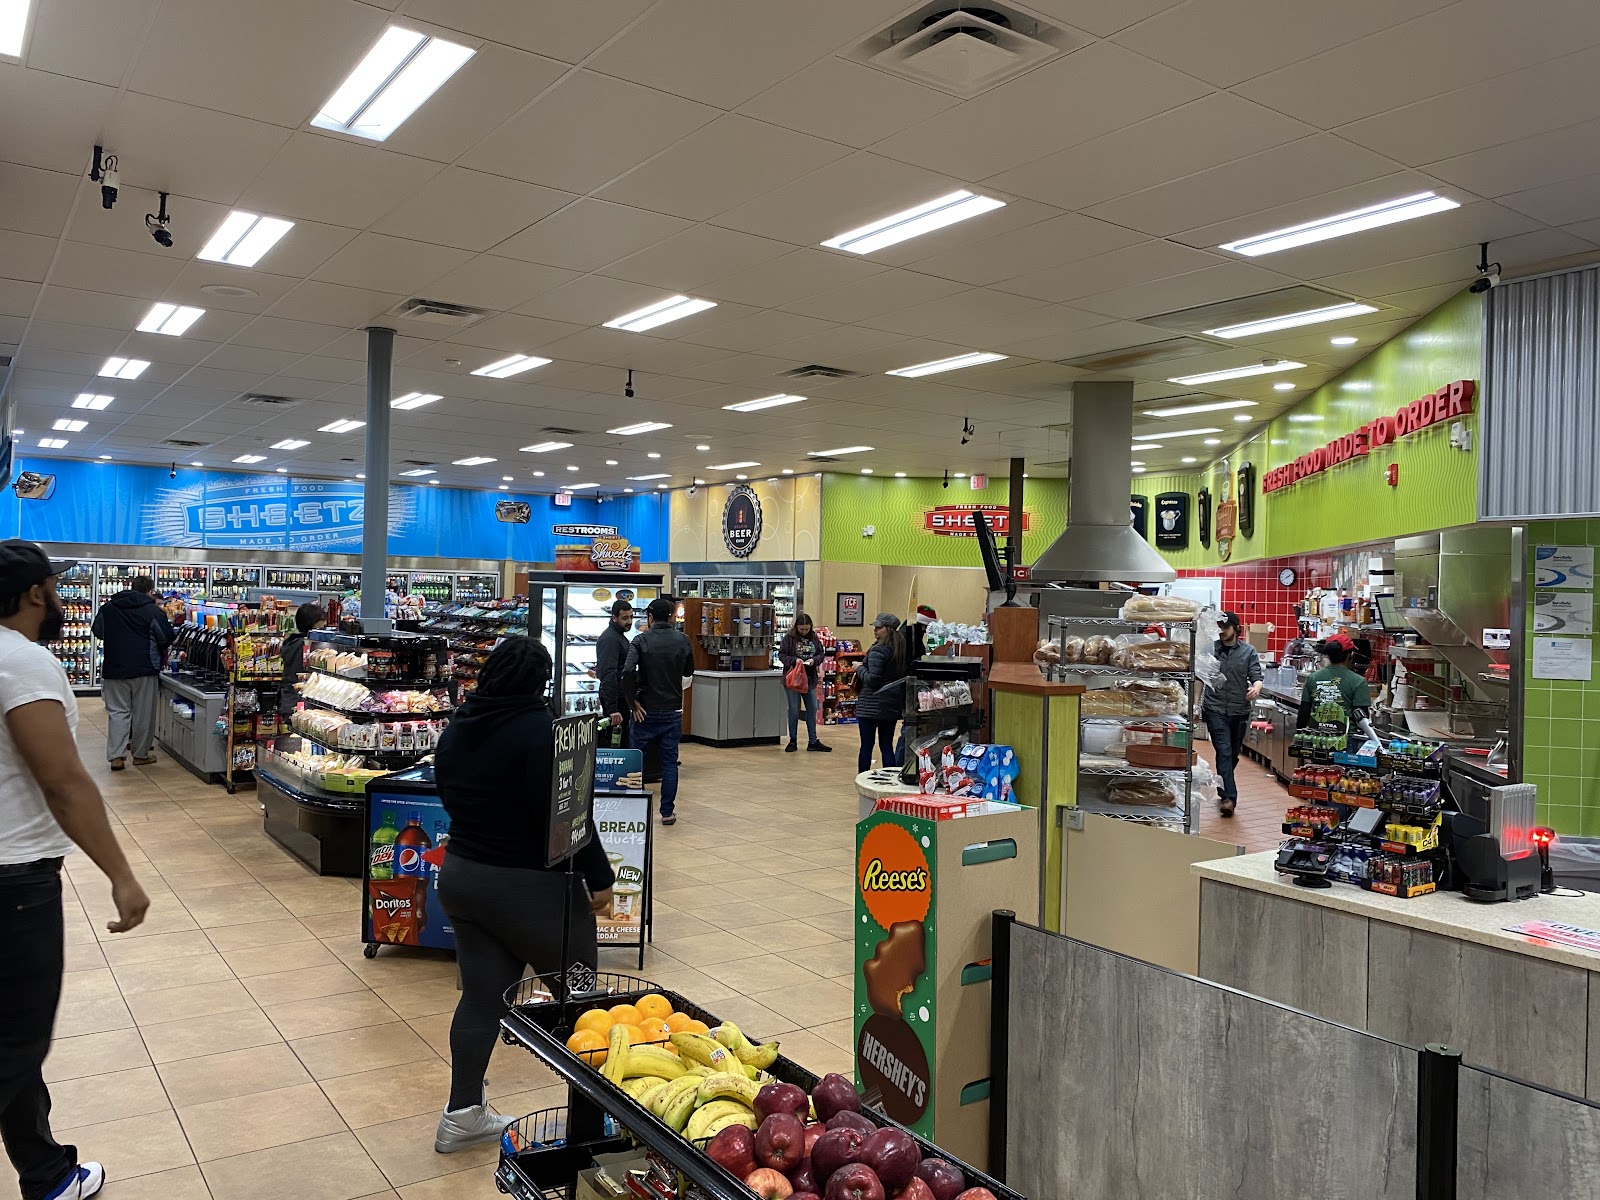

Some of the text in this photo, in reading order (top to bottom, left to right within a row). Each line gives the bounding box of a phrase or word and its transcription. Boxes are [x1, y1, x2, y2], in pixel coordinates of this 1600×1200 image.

[1262, 380, 1468, 495] FRESH FOOD MADE TO ORDER
[245, 484, 324, 494] FRESH FOOD
[198, 499, 364, 530] SHEETZ
[932, 514, 1008, 527] SHEET
[555, 526, 615, 535] RESTROOMS
[730, 529, 752, 538] BEER
[240, 537, 272, 545] MADE
[301, 533, 339, 542] ORDER
[591, 542, 632, 560] Shweetz
[554, 717, 595, 758] FRESH FRUIT
[595, 757, 624, 765] WEETZ
[599, 821, 646, 833] BREAD
[600, 832, 645, 845] oducts
[1422, 837, 1432, 848] C4
[619, 868, 641, 882] NEW
[863, 858, 927, 891] Reese's
[375, 898, 411, 910] Doritos
[862, 1032, 926, 1108] HERSHEY'S
